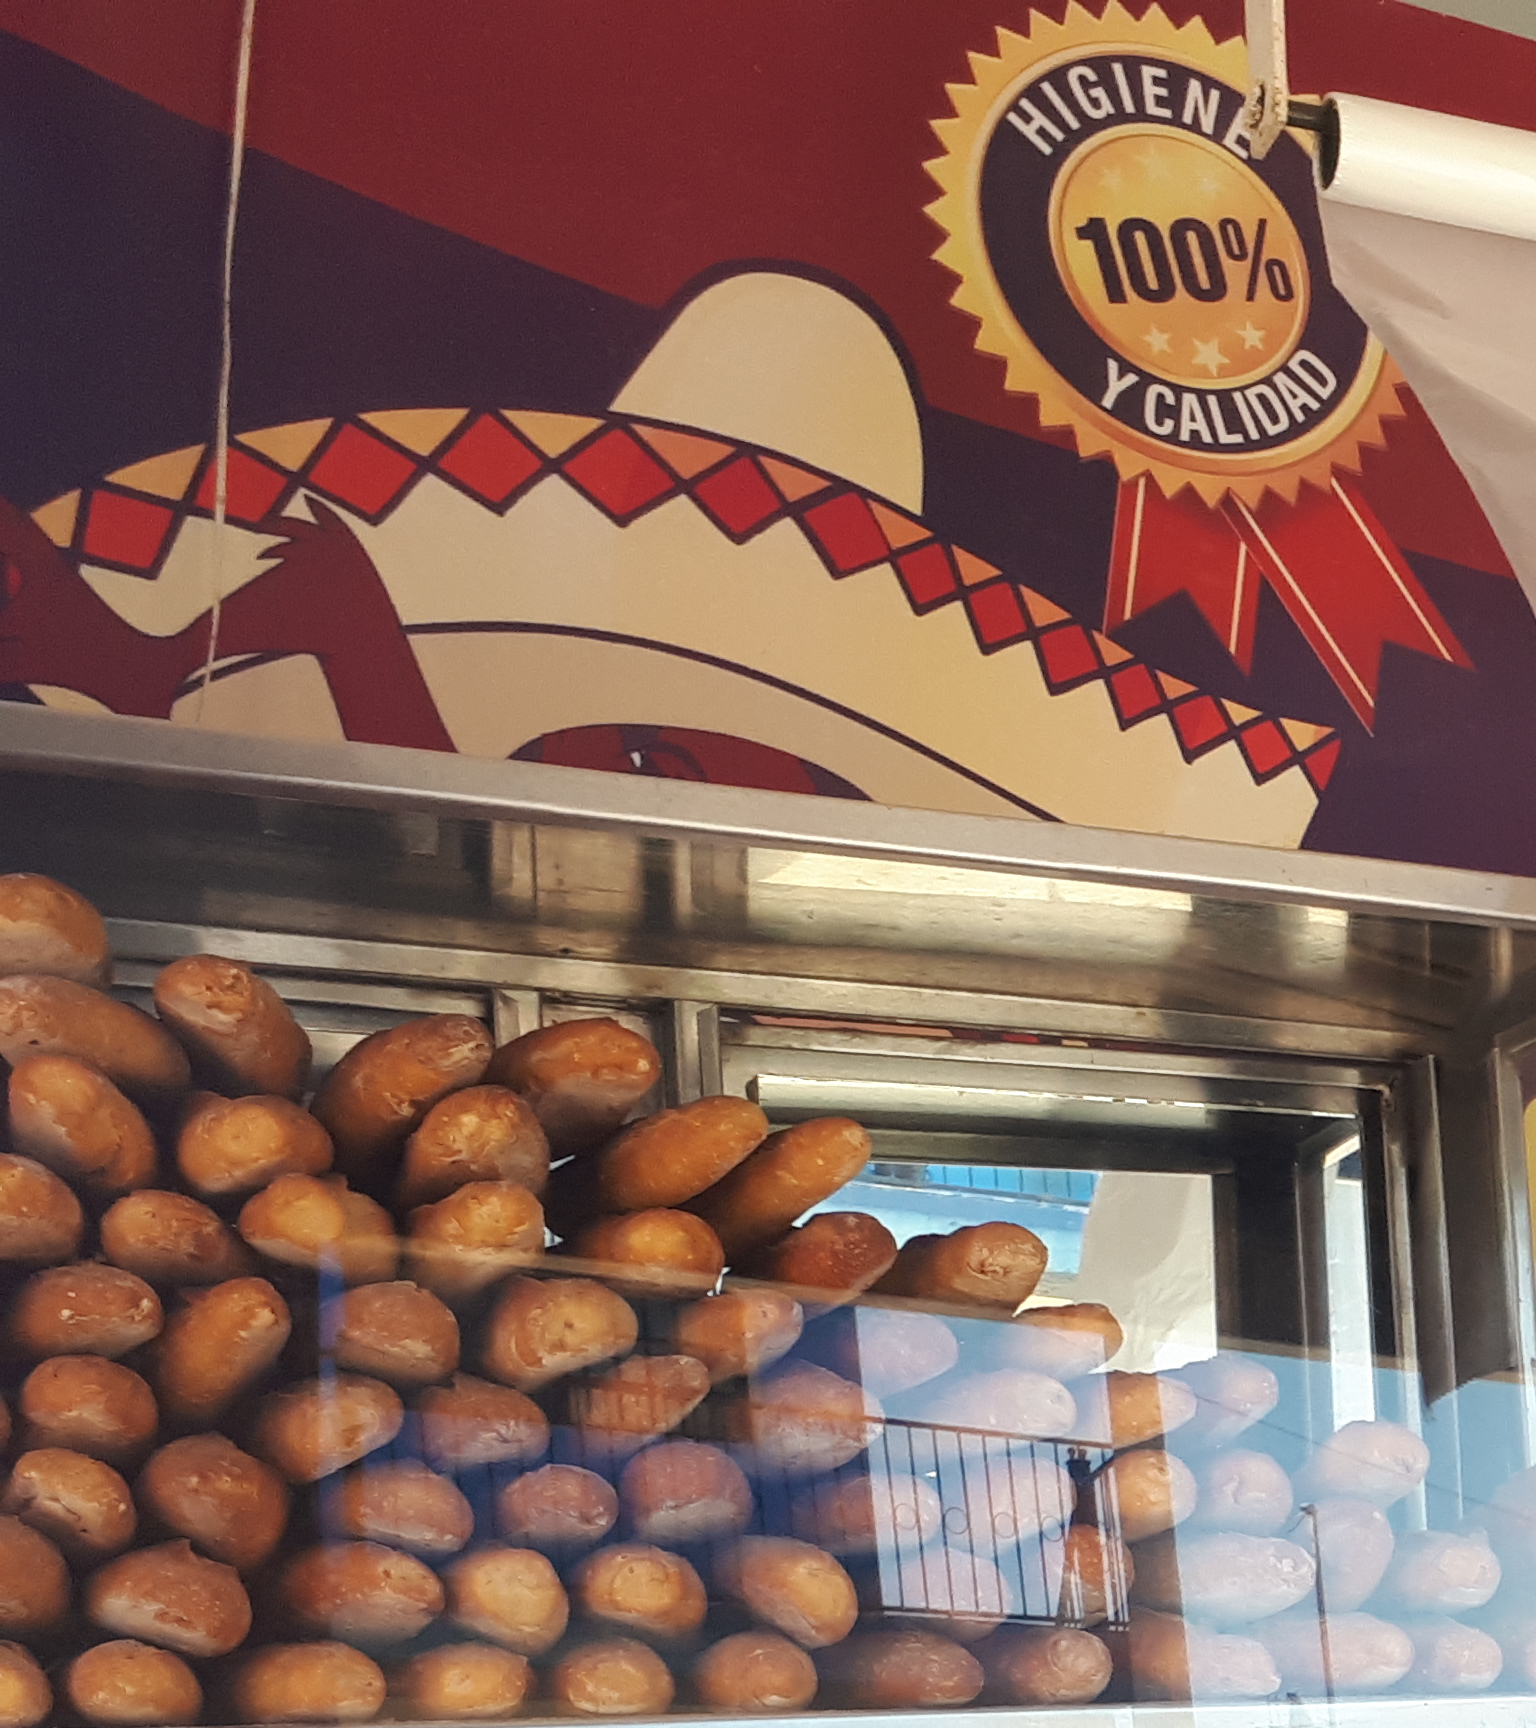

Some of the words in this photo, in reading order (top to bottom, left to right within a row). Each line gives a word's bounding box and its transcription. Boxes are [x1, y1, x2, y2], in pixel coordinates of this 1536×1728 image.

[1006, 62, 1252, 159] HIGIENE
[1075, 217, 1295, 304] 100%
[1100, 357, 1140, 412] Y
[1143, 348, 1338, 446] CALIDAD
